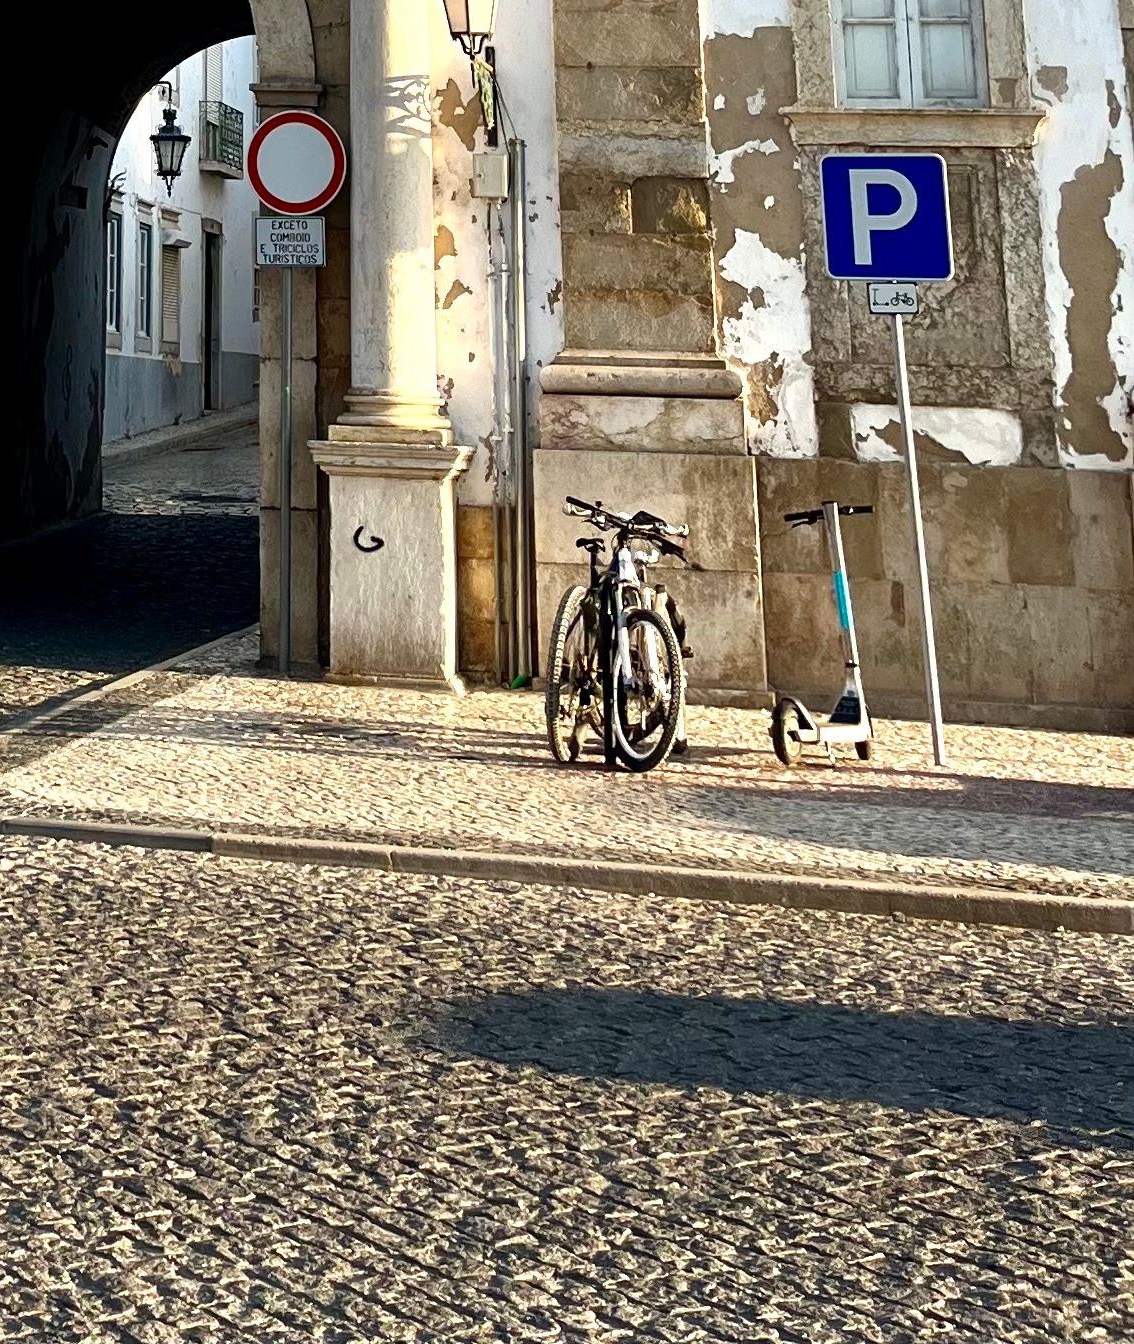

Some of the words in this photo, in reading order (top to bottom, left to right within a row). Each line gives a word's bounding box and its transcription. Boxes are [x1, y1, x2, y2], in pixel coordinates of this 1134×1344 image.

[848, 168, 918, 265] P
[271, 220, 308, 230] EXCETO
[269, 233, 311, 242] COMBOIO
[260, 244, 267, 253] E
[272, 243, 320, 254] TRICICLOS
